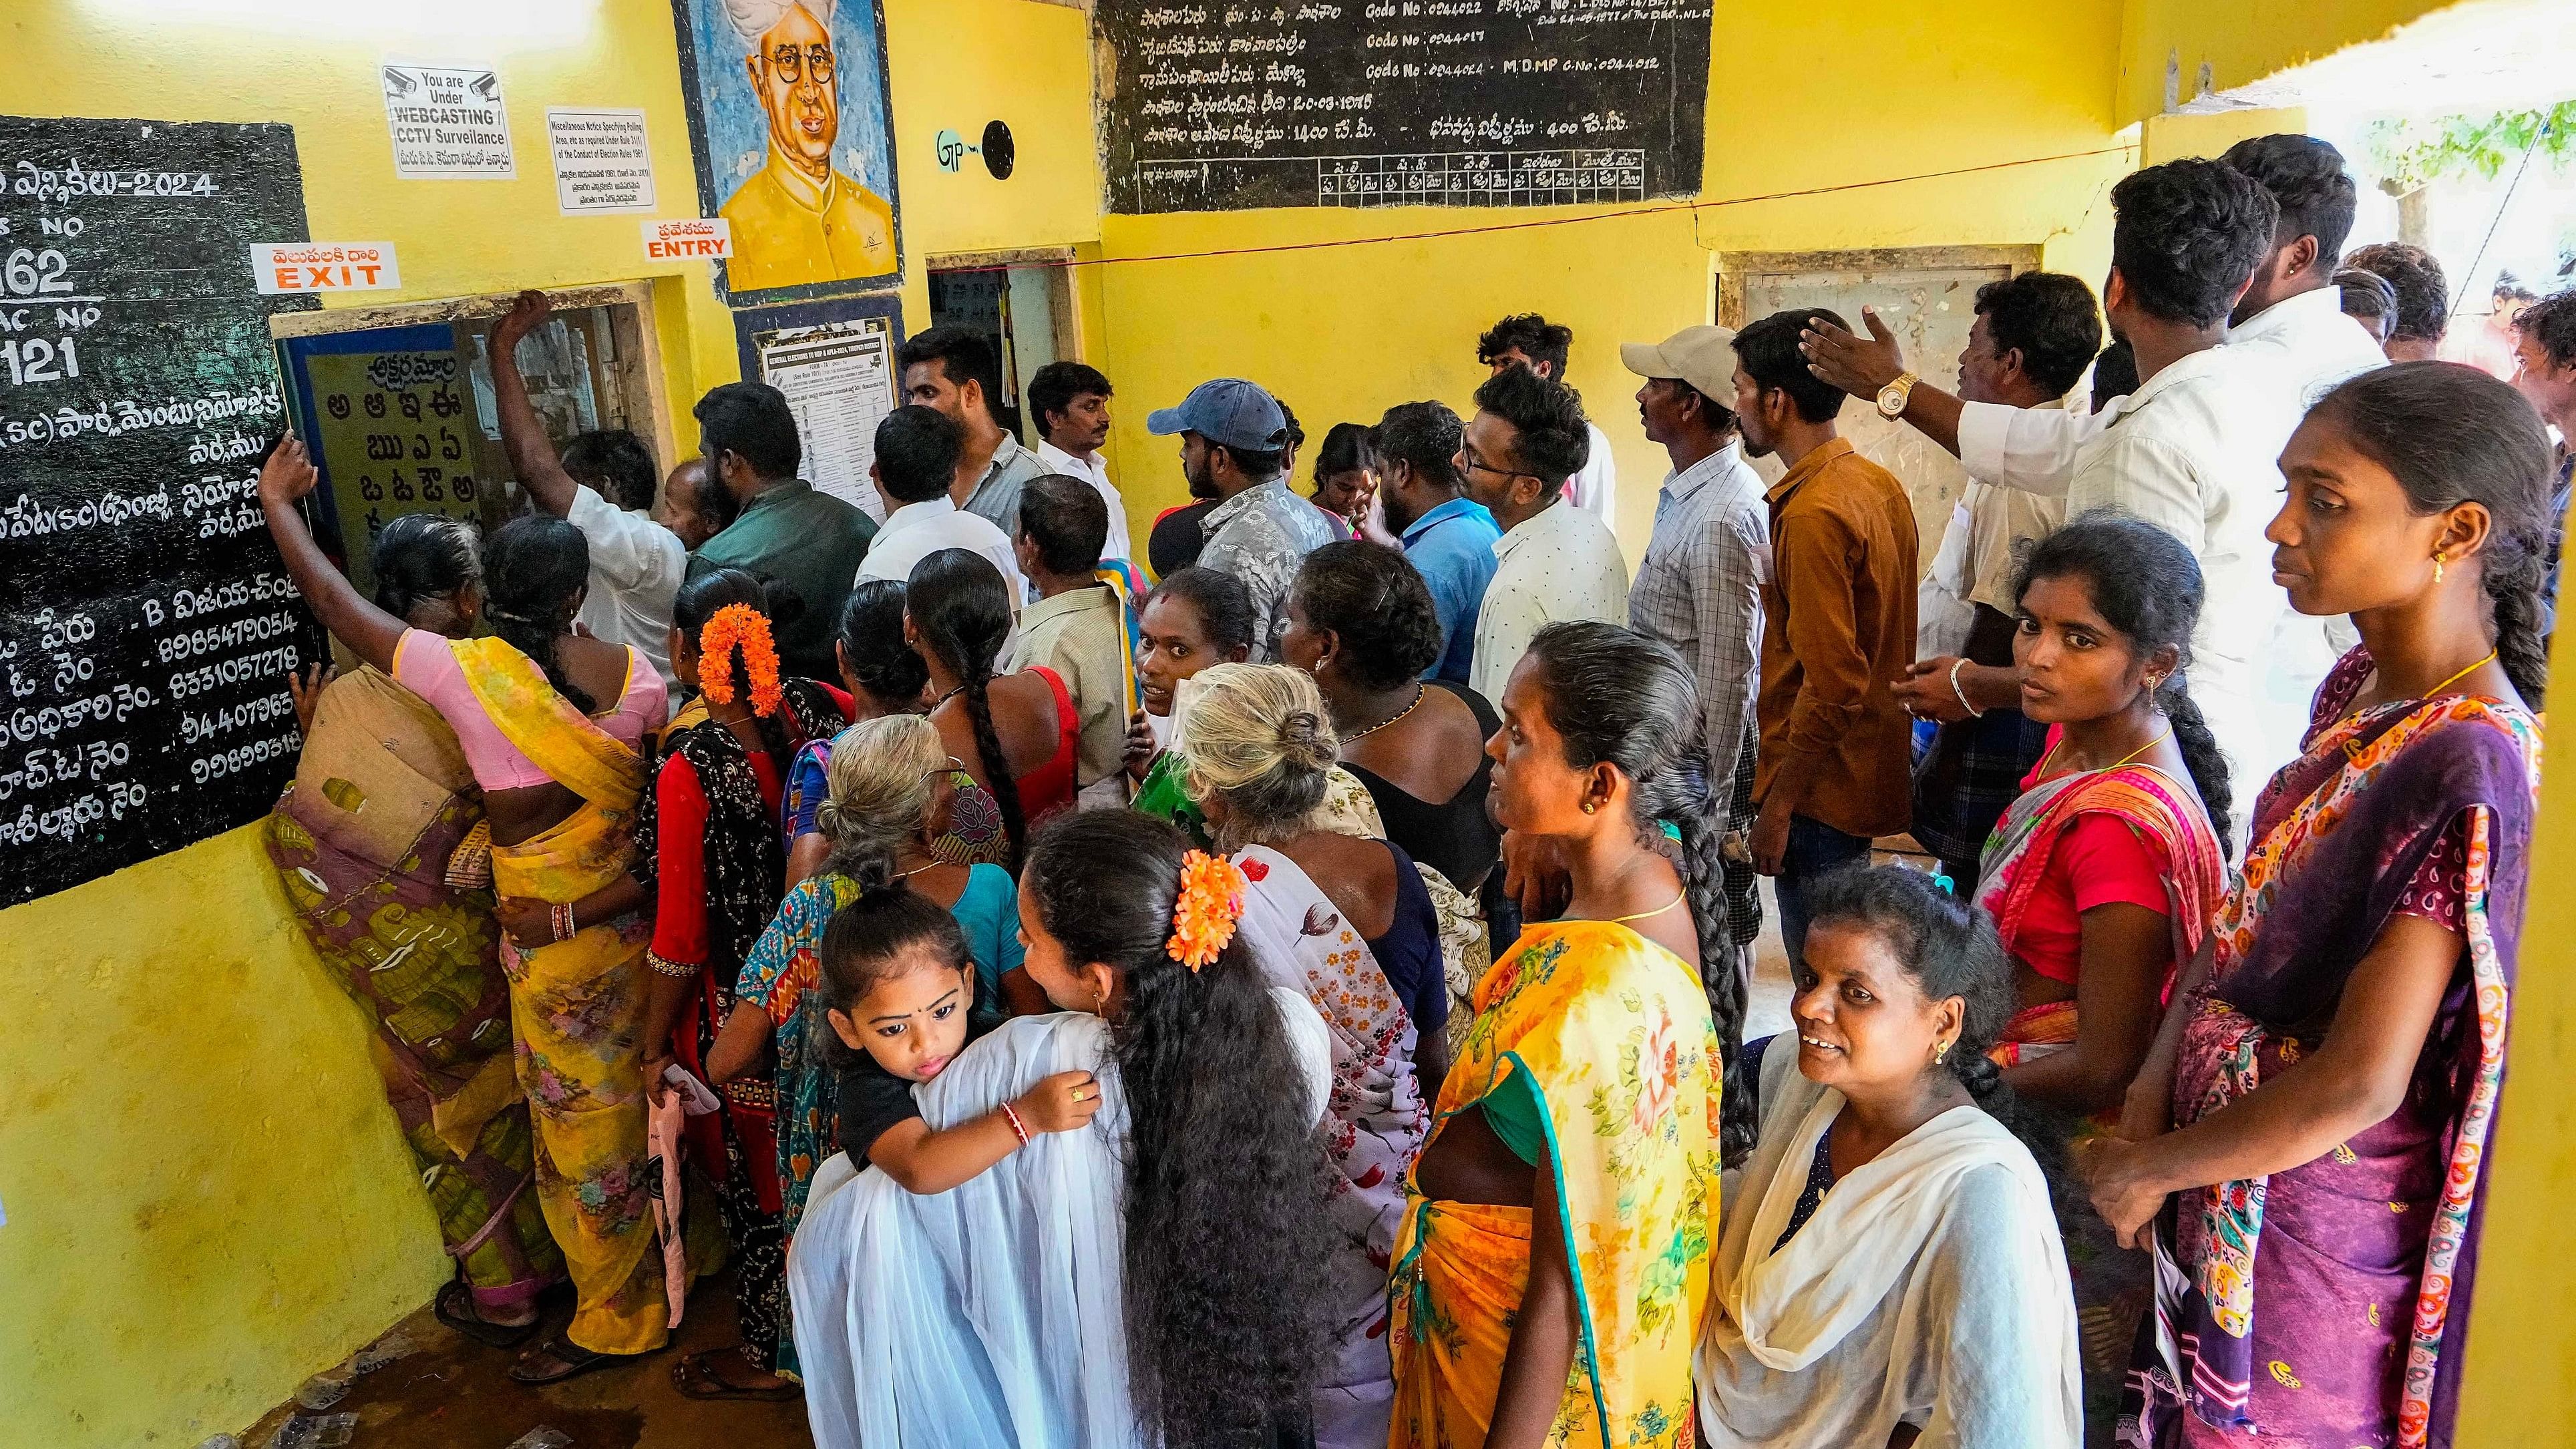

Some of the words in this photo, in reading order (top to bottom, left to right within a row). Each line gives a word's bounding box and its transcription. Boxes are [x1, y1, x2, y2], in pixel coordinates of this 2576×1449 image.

[1367, 31, 1398, 48] Code
[1366, 59, 1399, 79] Code
[421, 72, 443, 87] You
[446, 77, 464, 87] are
[429, 89, 463, 104] Under
[394, 107, 493, 125] WEBCASTING
[397, 127, 431, 143] CCTV
[435, 128, 504, 144] Surveilance
[551, 121, 586, 131] Miscellaneous
[586, 122, 601, 131] Notice
[602, 122, 626, 133] Specifying
[627, 122, 642, 133] Polling
[1547, 122, 1578, 138] 400
[556, 136, 569, 145] Area,
[585, 136, 605, 146] required
[606, 136, 619, 144] Under
[620, 136, 630, 144] Rule
[558, 150, 564, 158] of
[564, 150, 572, 158] the
[573, 150, 594, 158] Conduct
[594, 150, 599, 158] of
[600, 150, 618, 158] Election
[619, 150, 632, 158] Rules
[632, 149, 644, 158] 1961
[659, 222, 715, 240] ప్రవేశము
[272, 247, 345, 264] వెలుపలకి
[347, 249, 379, 262] దారి
[649, 239, 725, 258] ENTRY
[0, 248, 73, 295] 62
[274, 265, 381, 288] EXIT
[0, 336, 79, 385] 121
[327, 393, 350, 420] అ
[398, 393, 422, 422] ఇ
[142, 599, 164, 627] B
[158, 610, 298, 663] 8985479054
[169, 645, 299, 699] 8331057278
